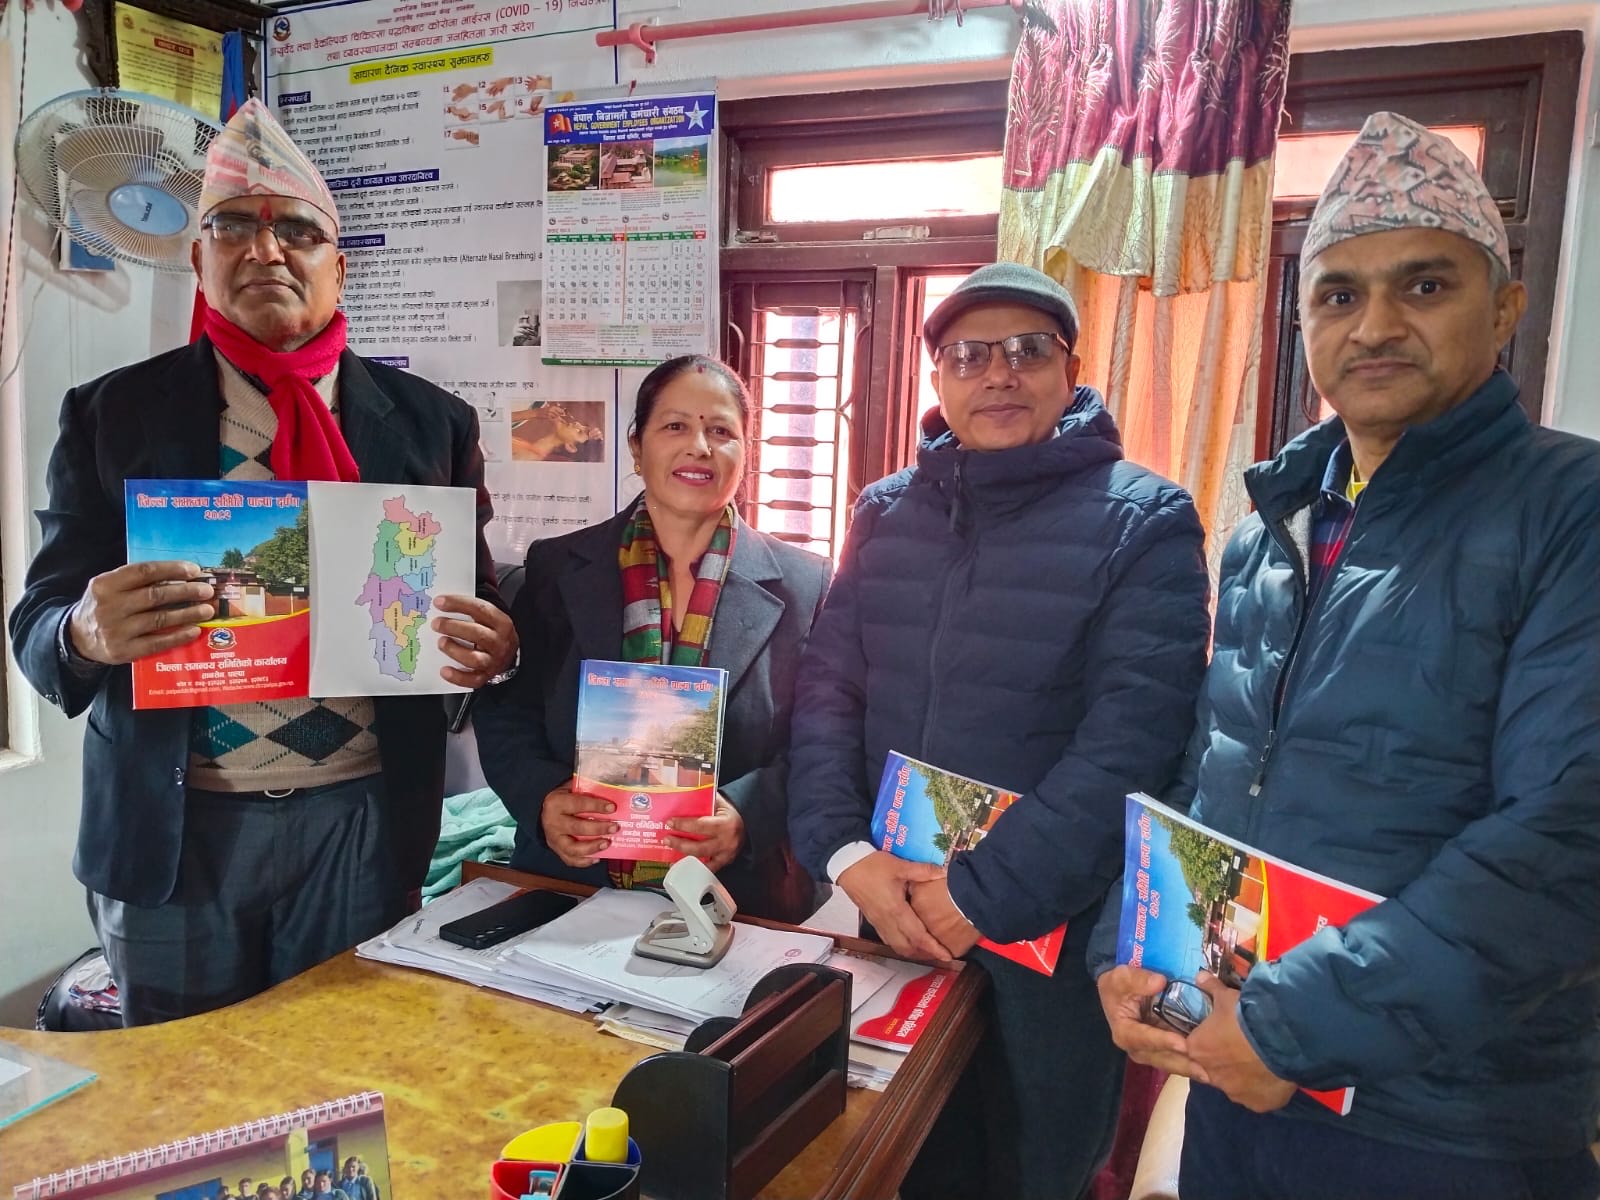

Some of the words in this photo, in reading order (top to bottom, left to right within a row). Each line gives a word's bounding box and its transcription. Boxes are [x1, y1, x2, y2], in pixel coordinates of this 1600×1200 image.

[296, 42, 311, 52] तथा
[494, 4, 530, 22] (COVID
[326, 51, 341, 62] तथा
[489, 24, 508, 36] जारी
[352, 67, 382, 81] साधारण
[384, 62, 409, 76] दैनिक
[573, 112, 593, 123] नेपाल
[573, 122, 589, 130] NEPAL
[136, 493, 168, 508] जिल्ला
[213, 493, 244, 508] समिति
[155, 661, 182, 673] जिल्ला
[184, 662, 215, 672] समन्वय
[218, 658, 253, 669] समितिको
[254, 656, 288, 667] कार्यालय
